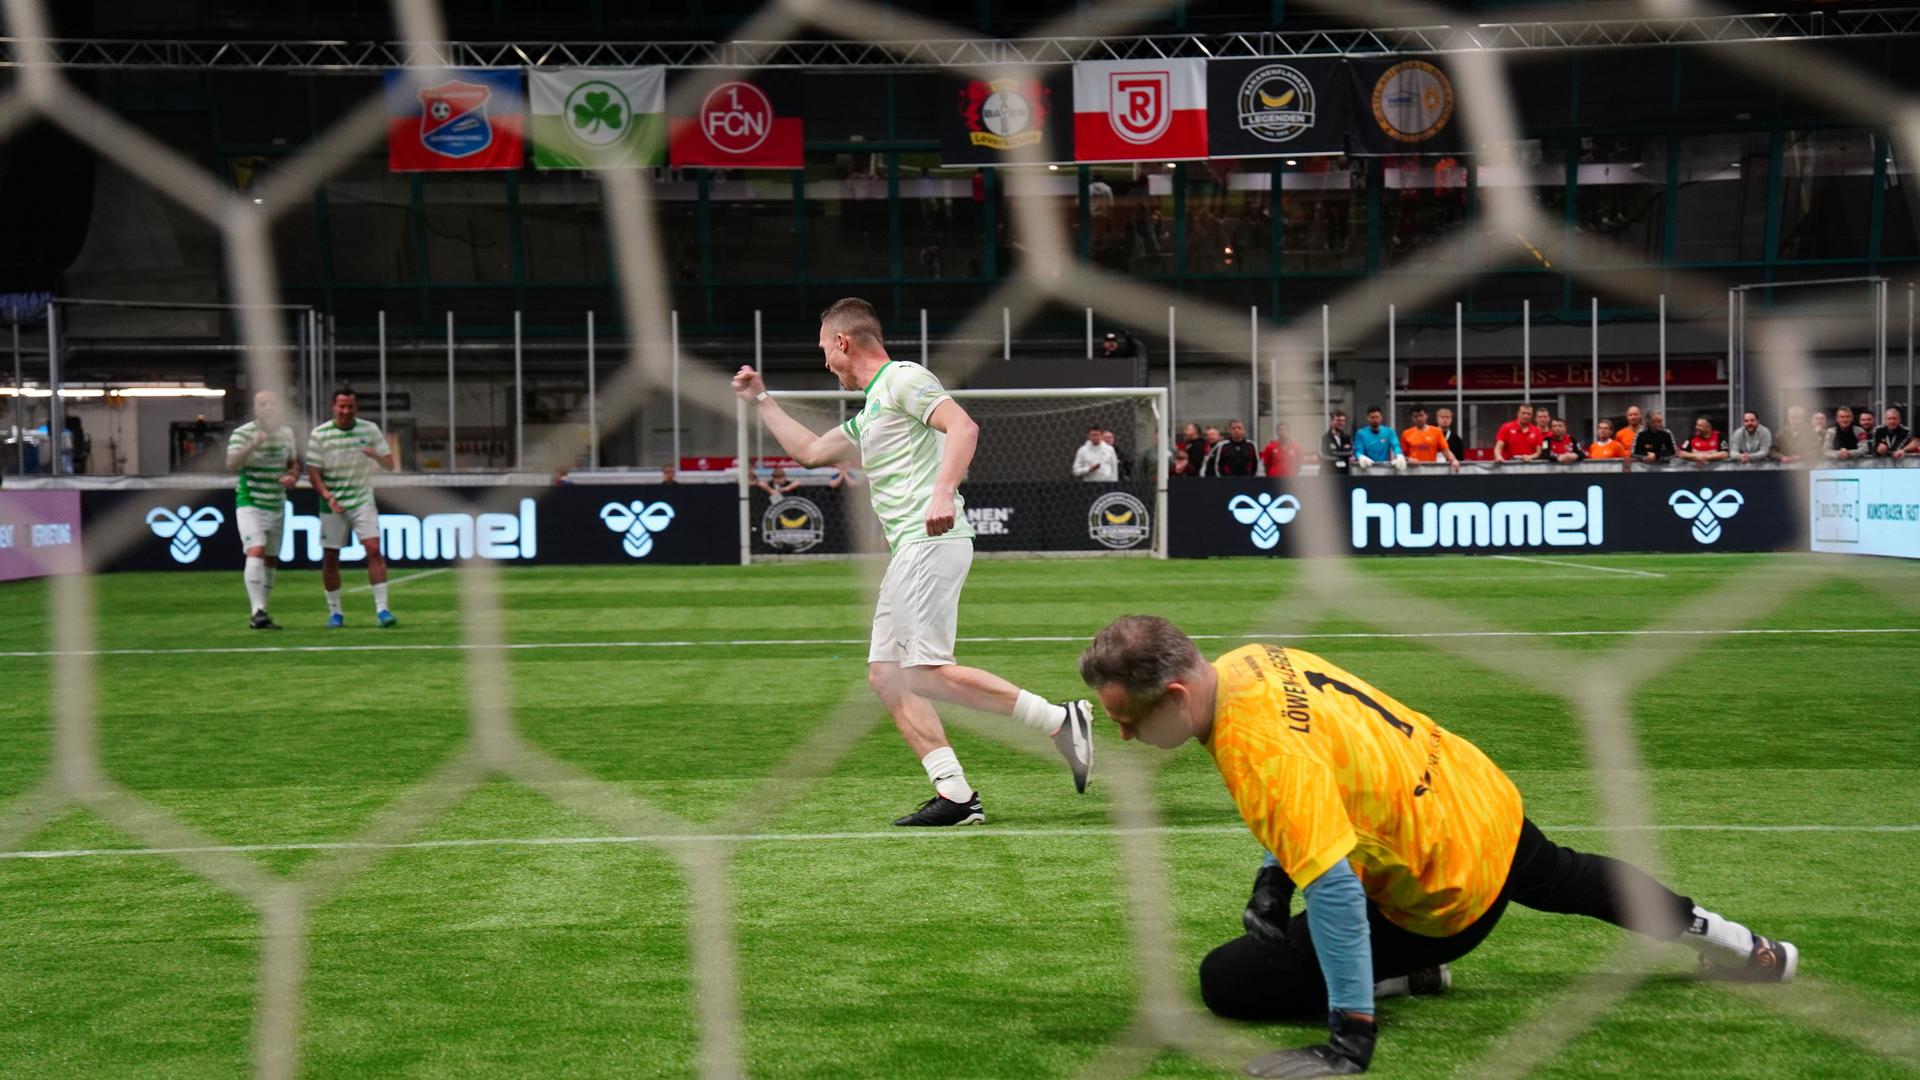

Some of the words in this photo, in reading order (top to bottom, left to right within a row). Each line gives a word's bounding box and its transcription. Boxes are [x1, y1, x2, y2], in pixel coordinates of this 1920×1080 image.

[709, 112, 763, 136] FCN
[1249, 114, 1305, 124] LEGENDEN
[1351, 485, 1603, 549] hummel
[1262, 645, 1310, 733] LÖWEN-LEGEN
[1303, 670, 1414, 739] 1
